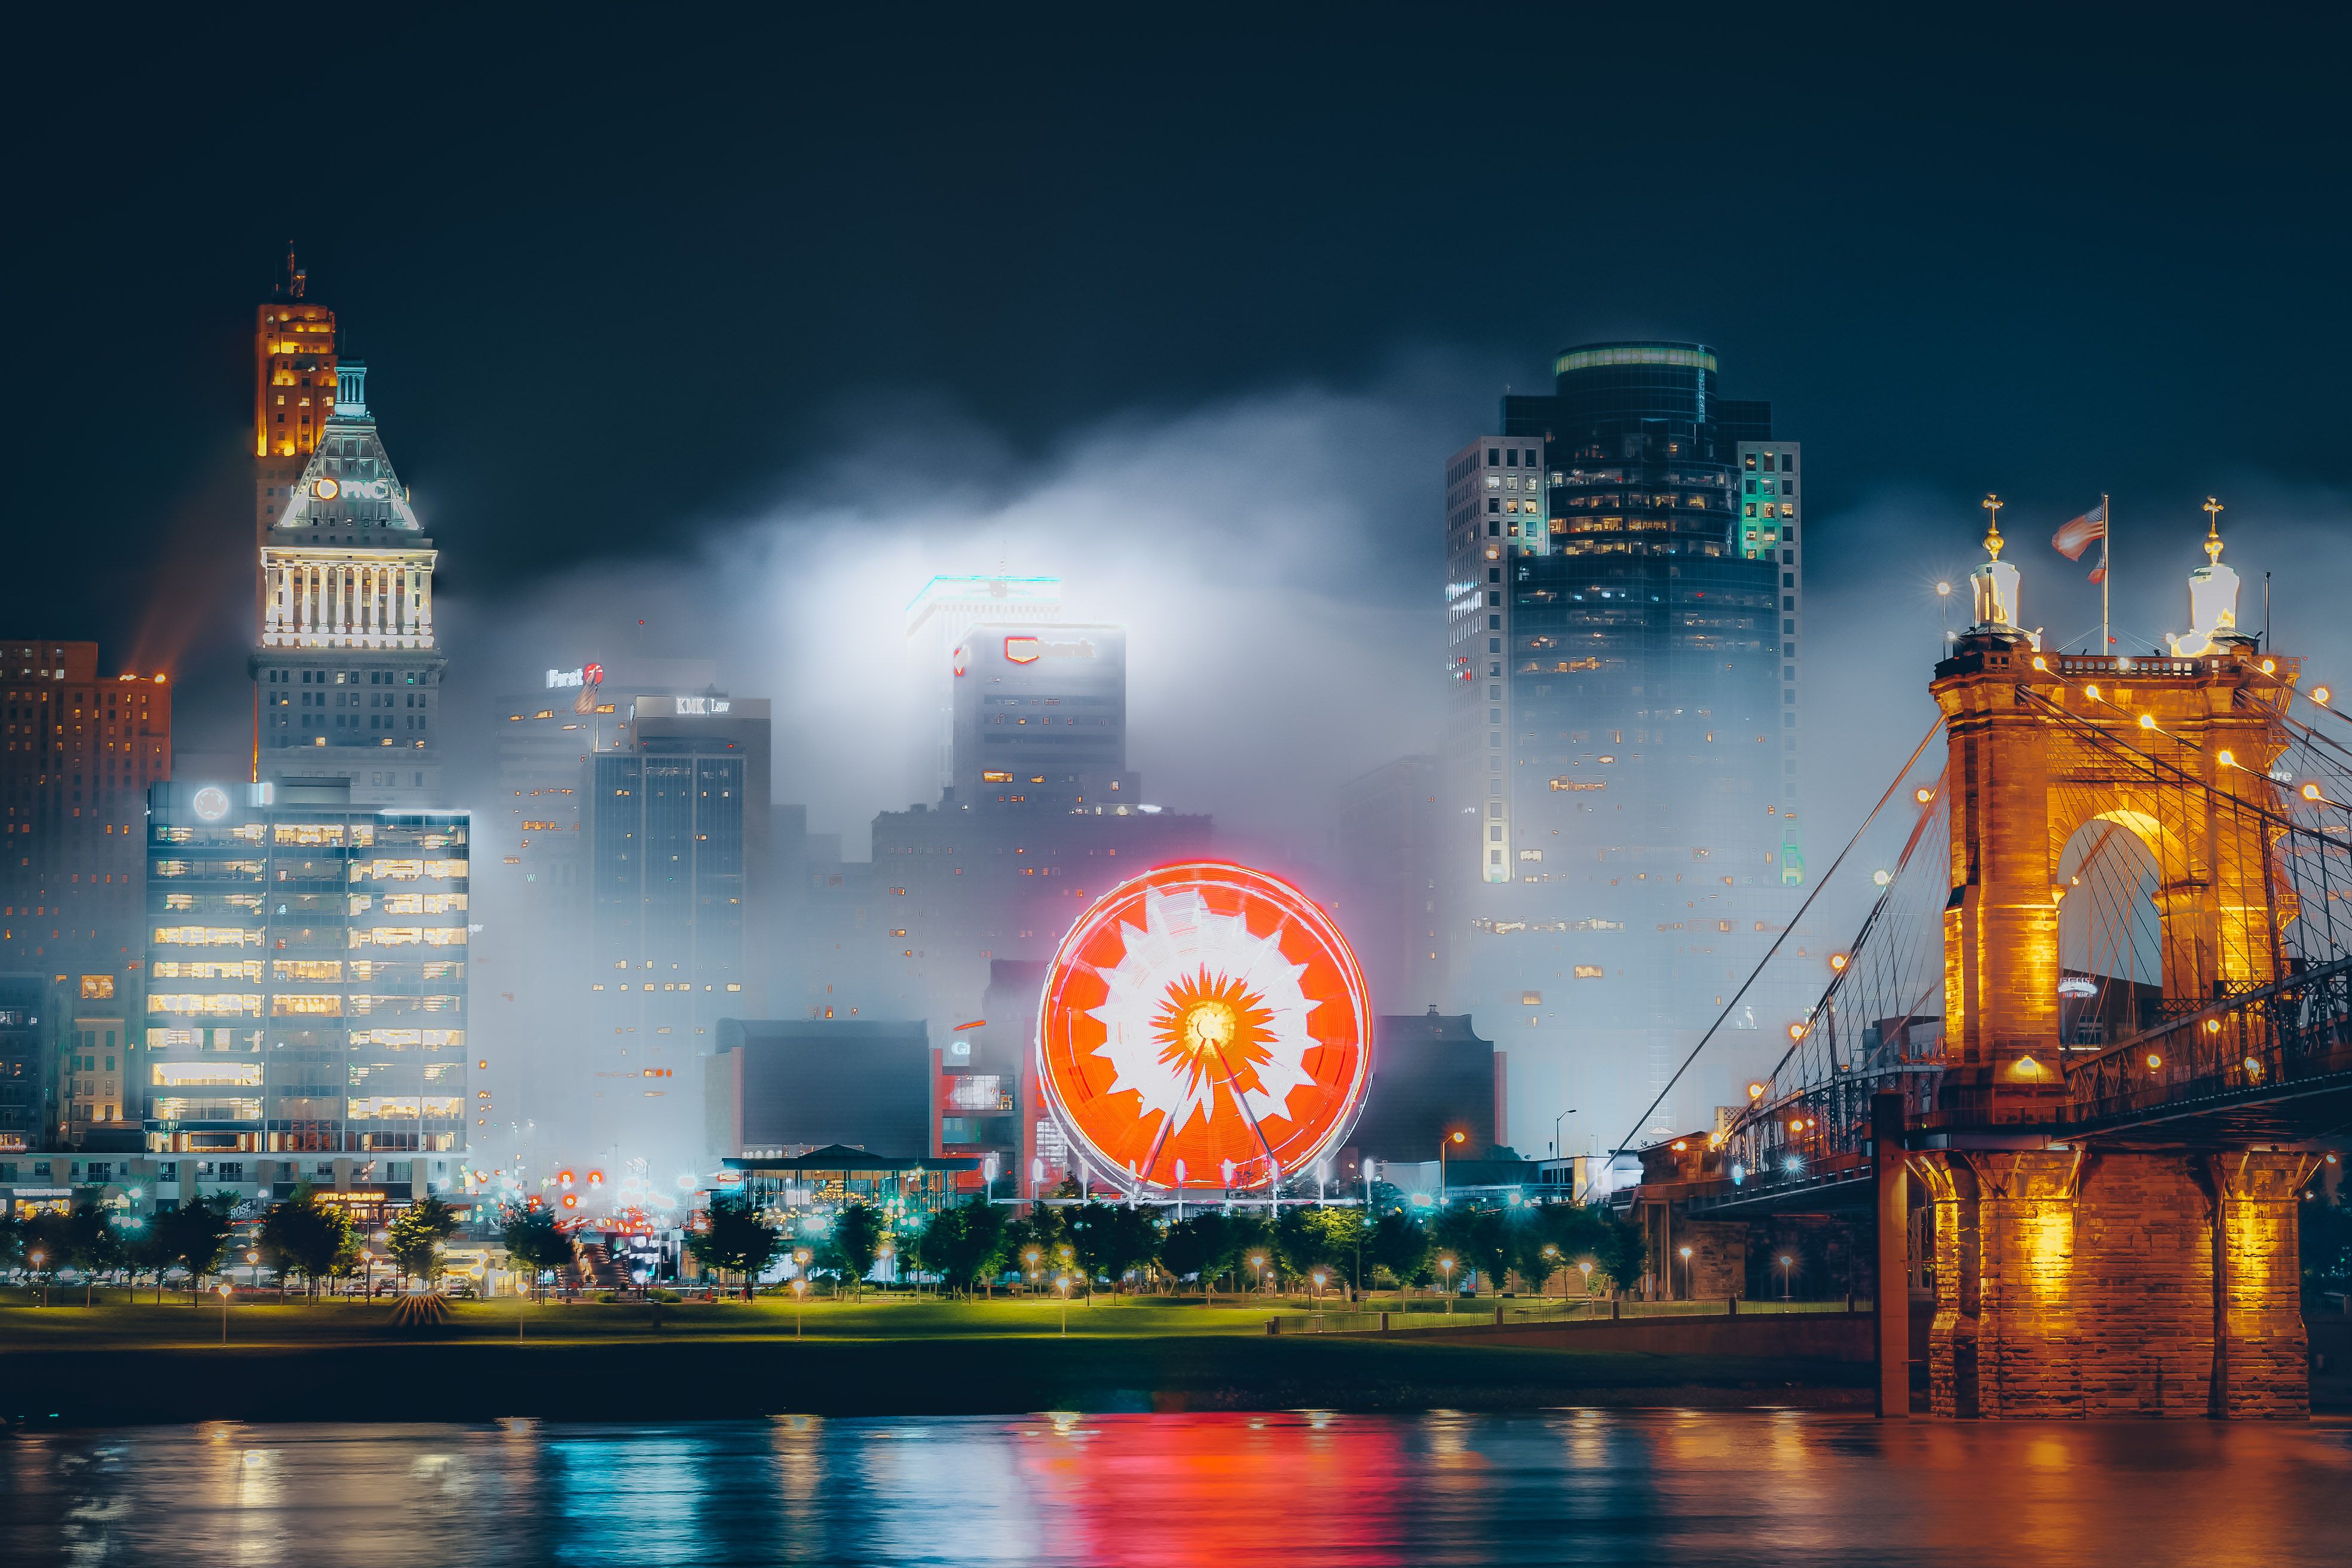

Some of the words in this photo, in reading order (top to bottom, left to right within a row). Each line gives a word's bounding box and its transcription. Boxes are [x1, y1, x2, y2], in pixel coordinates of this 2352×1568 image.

[341, 481, 385, 498] PNC
[549, 668, 583, 688] First
[677, 697, 705, 714] KMK
[711, 699, 730, 712] Law
[230, 1200, 251, 1220] ROSE
